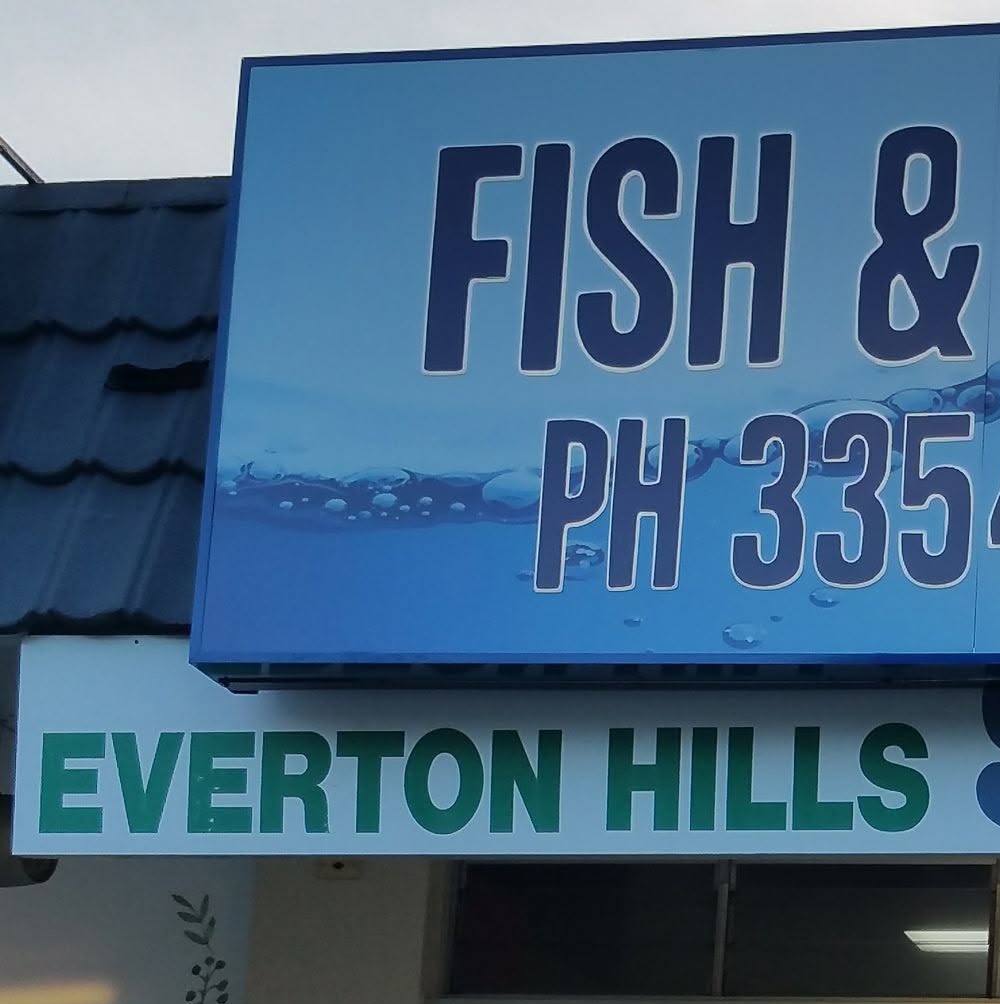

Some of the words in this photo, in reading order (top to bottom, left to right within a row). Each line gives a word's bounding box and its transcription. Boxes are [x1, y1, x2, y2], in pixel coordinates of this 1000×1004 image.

[421, 131, 795, 377] FISH
[855, 123, 983, 369] &
[532, 414, 690, 594] PH
[37, 727, 564, 836] EVERTON
[605, 721, 931, 834] HILLS
